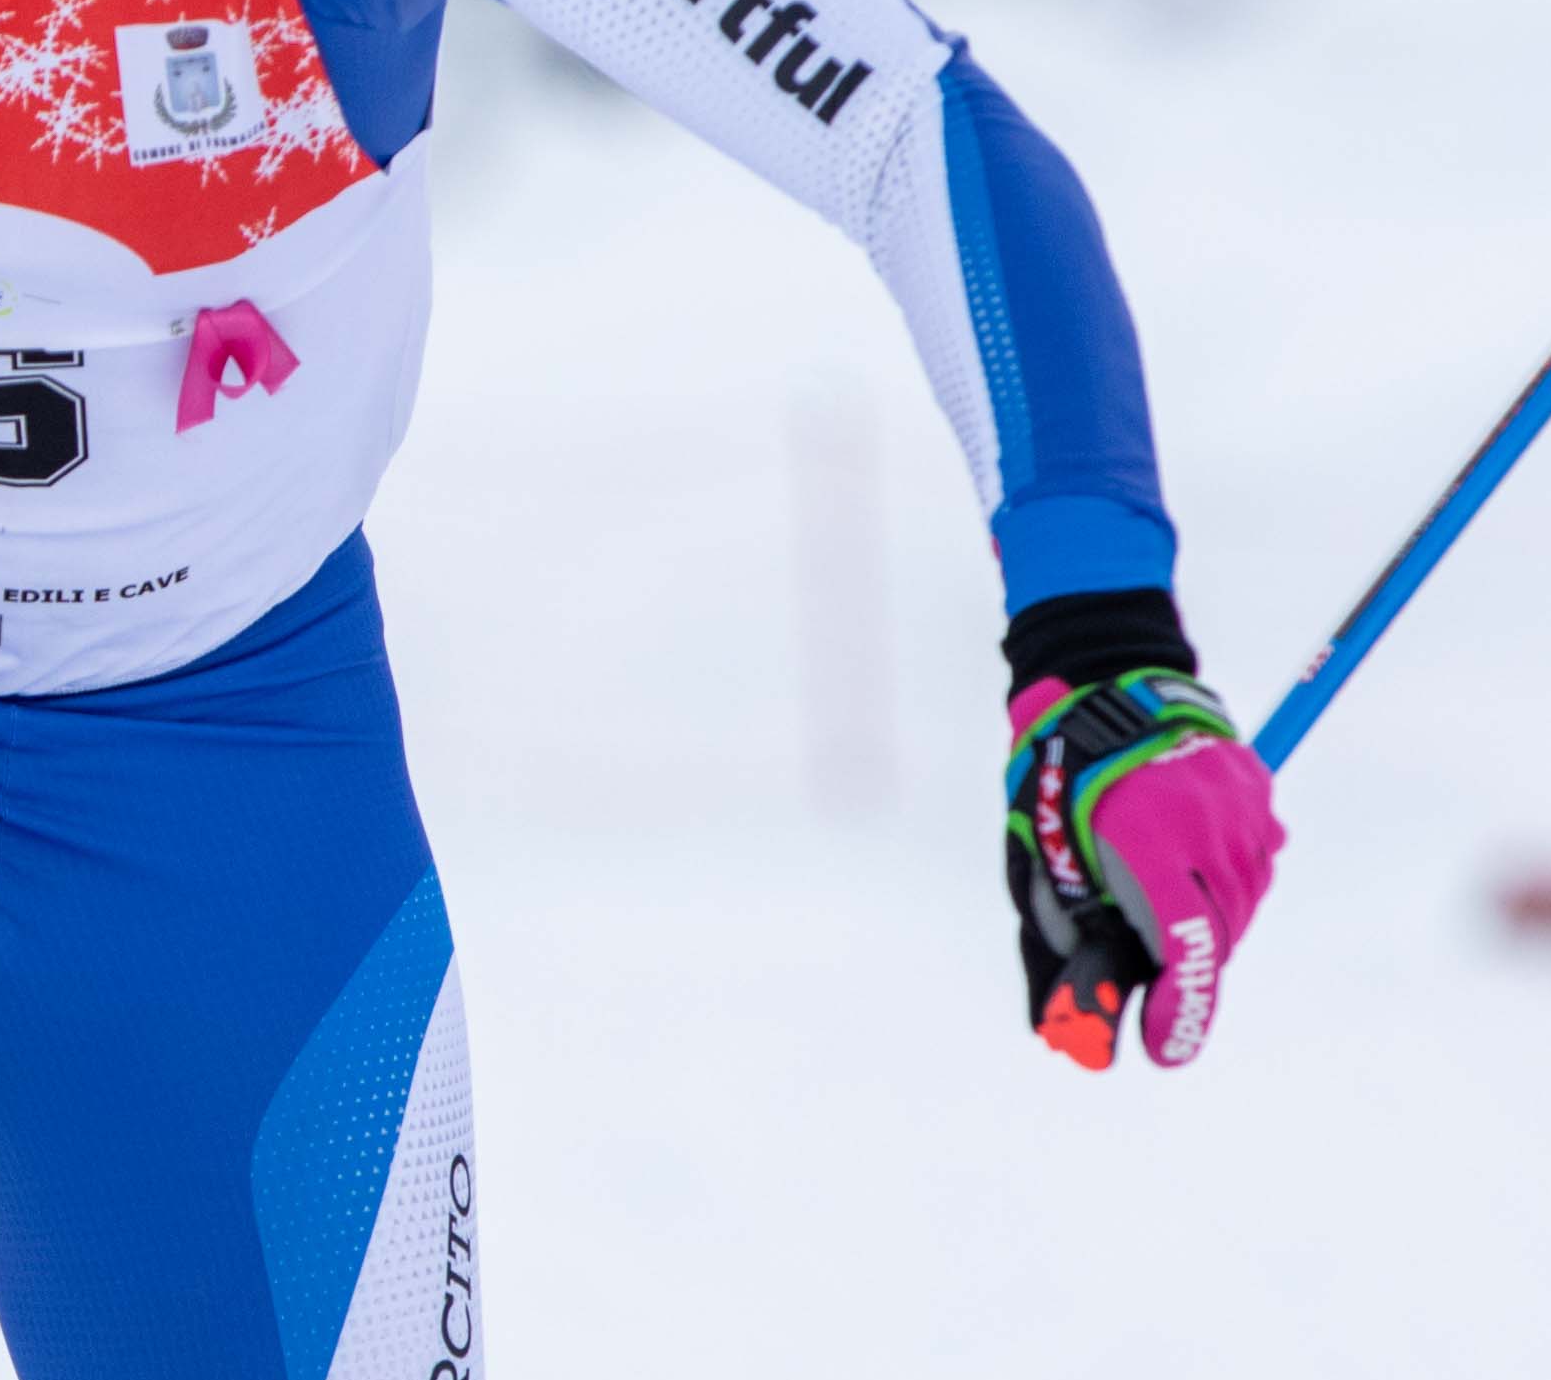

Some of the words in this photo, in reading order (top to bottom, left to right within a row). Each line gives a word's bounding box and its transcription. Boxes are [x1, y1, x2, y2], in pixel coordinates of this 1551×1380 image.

[3, 587, 85, 603] EDILI
[94, 587, 111, 602] E
[119, 565, 191, 599] CAVE
